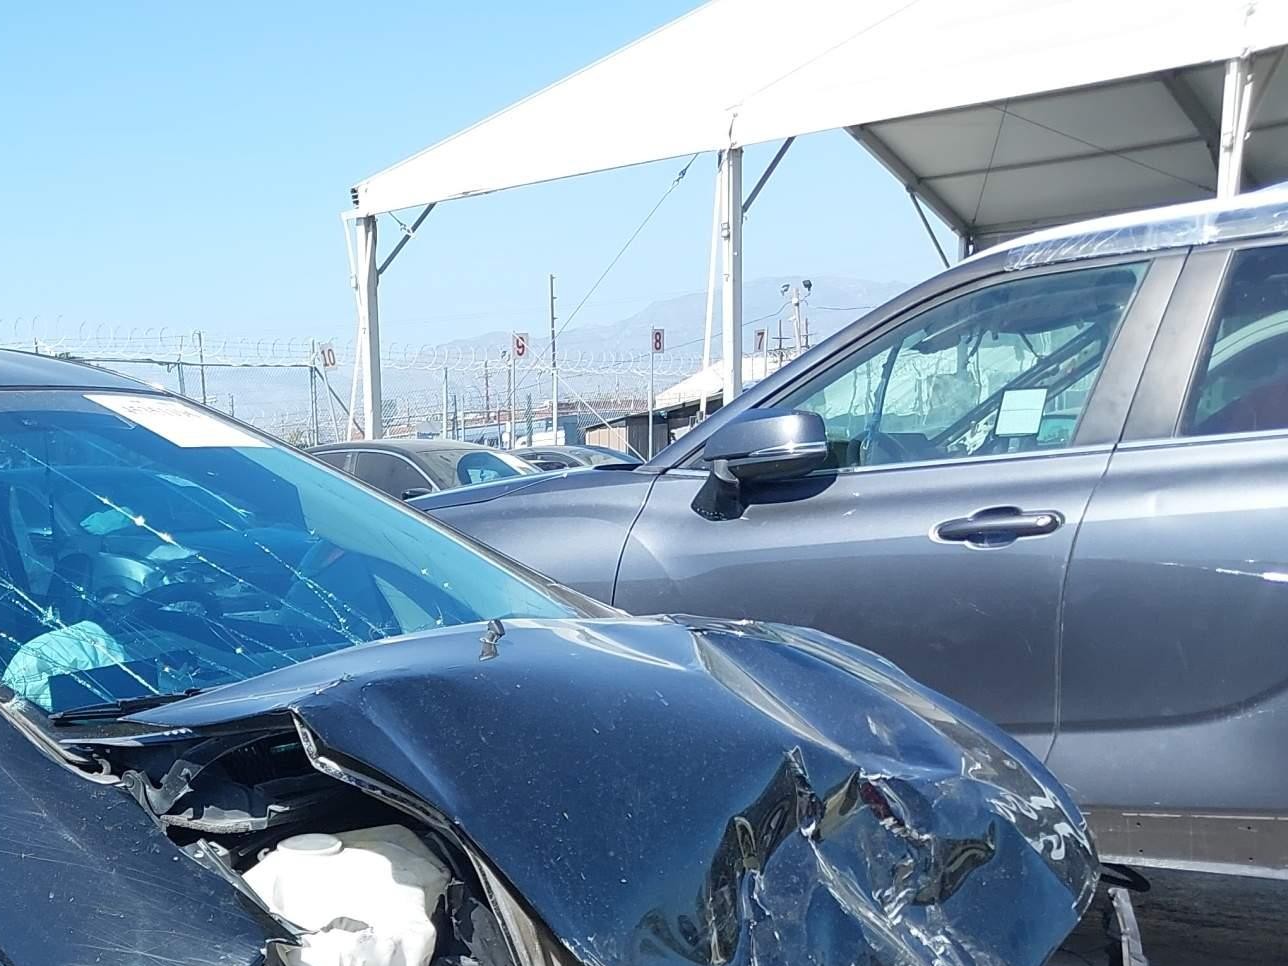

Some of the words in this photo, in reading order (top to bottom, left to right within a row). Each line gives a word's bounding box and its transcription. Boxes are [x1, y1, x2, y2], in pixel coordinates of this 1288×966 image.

[516, 335, 525, 357] 9
[654, 331, 662, 351] 8
[757, 331, 765, 350] 7
[321, 348, 336, 367] 10
